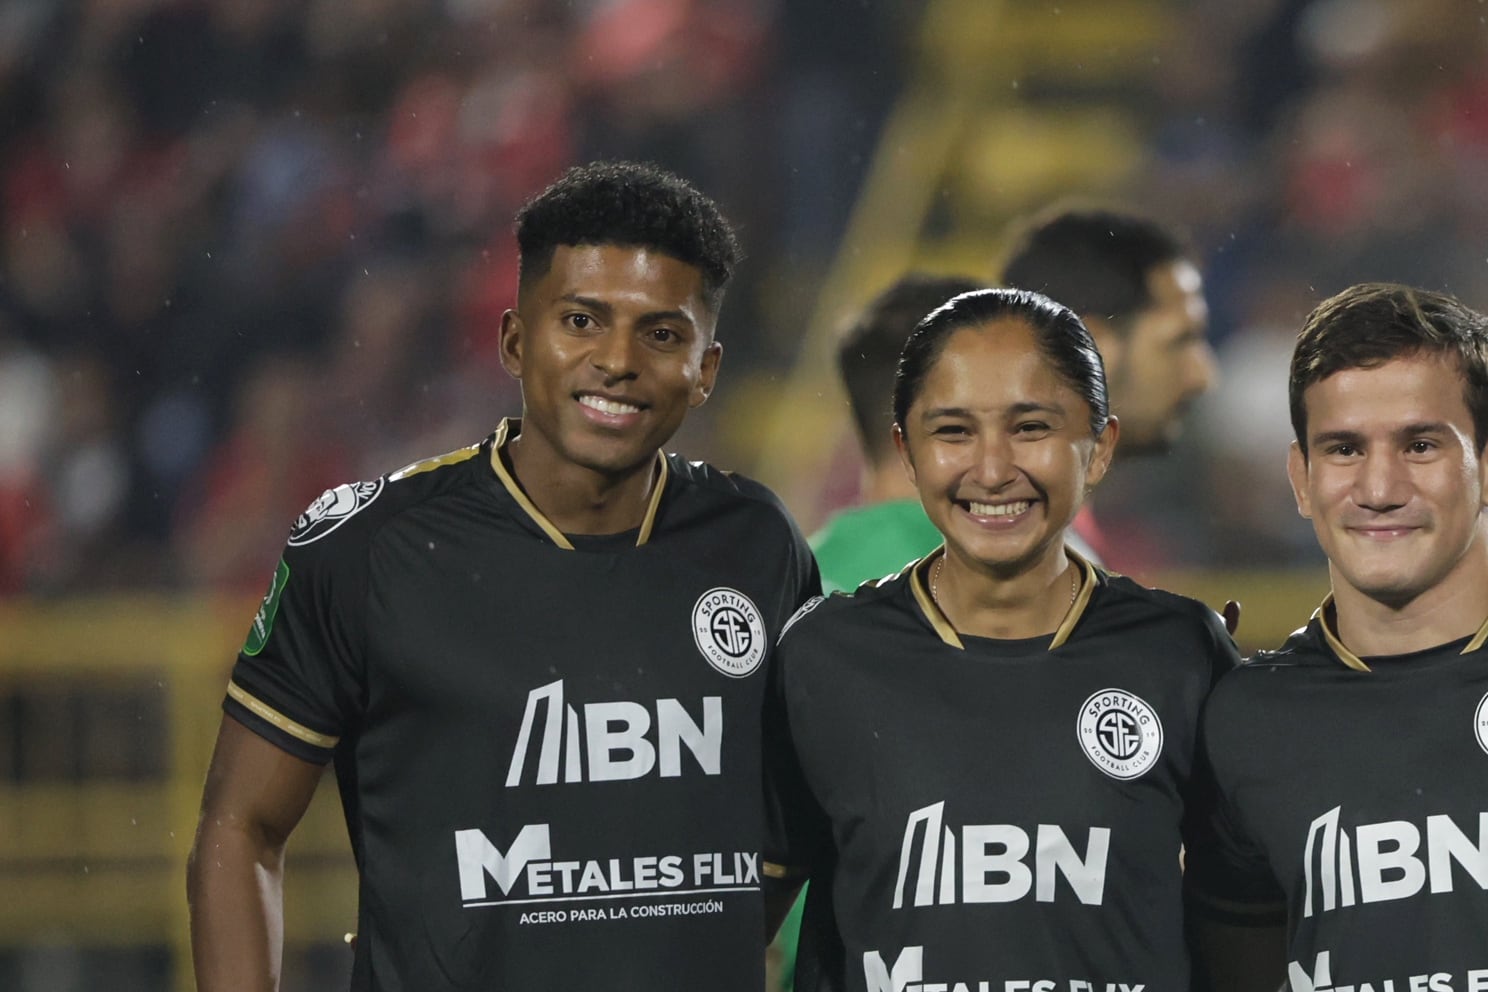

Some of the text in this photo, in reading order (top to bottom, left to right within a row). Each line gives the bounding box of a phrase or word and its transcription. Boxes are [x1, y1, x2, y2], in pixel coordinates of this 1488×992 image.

[702, 594, 756, 623] SPORTING
[708, 645, 743, 669] FOOTBALL
[1089, 696, 1150, 725] SPORTING
[1091, 746, 1150, 772] FOOTBALL CLUB
[455, 823, 760, 900] METALES FLIX
[519, 899, 723, 924] ACERO PARA LA CONSTRUCCIÓN
